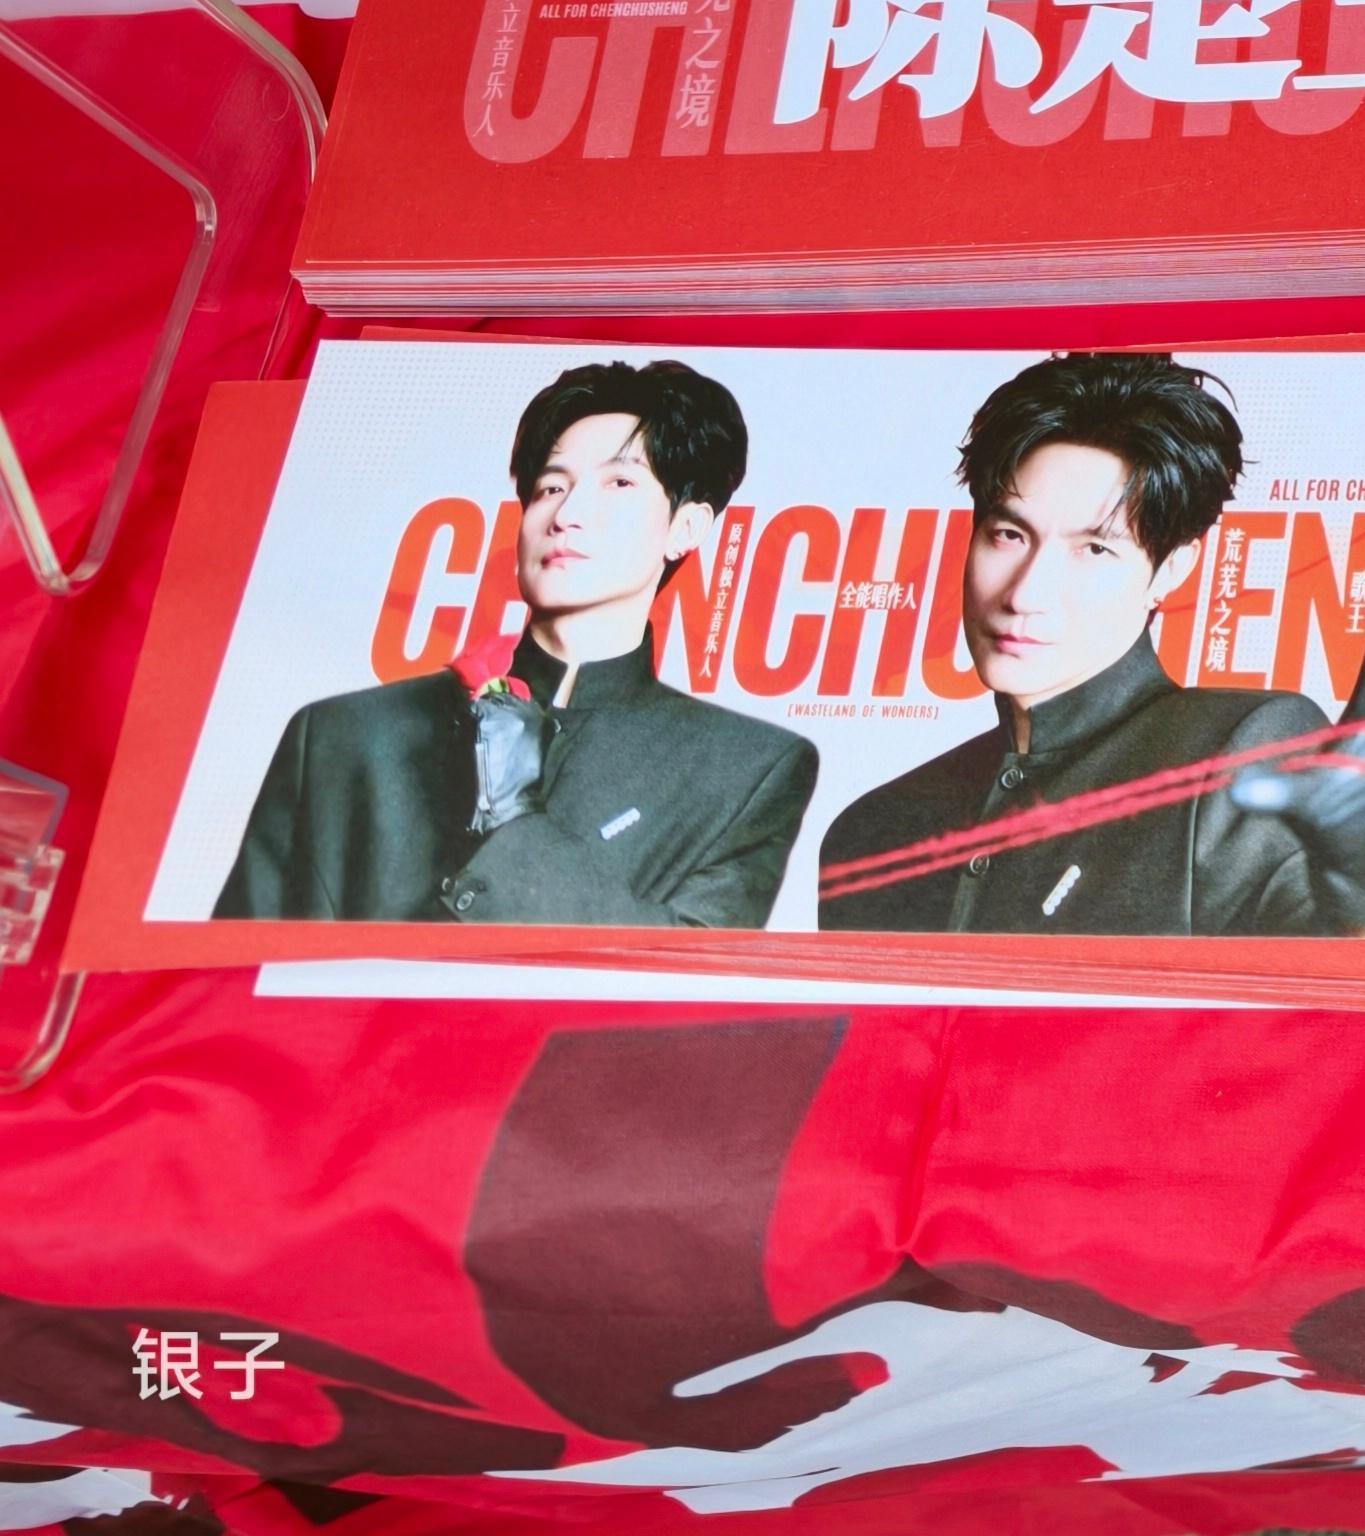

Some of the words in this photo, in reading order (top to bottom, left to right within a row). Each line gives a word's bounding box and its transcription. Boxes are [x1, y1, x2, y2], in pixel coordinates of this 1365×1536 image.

[539, 4, 561, 19] ALL
[564, 3, 587, 19] FOR
[590, 1, 688, 17] CHENCHUSHENG
[1269, 479, 1300, 501] ALL
[1306, 479, 1340, 501] FOR
[699, 523, 745, 678] 原创独立音乐人
[839, 581, 918, 610] 全能唱作人
[1205, 527, 1247, 673] 荒芜之境
[862, 705, 875, 719] OF
